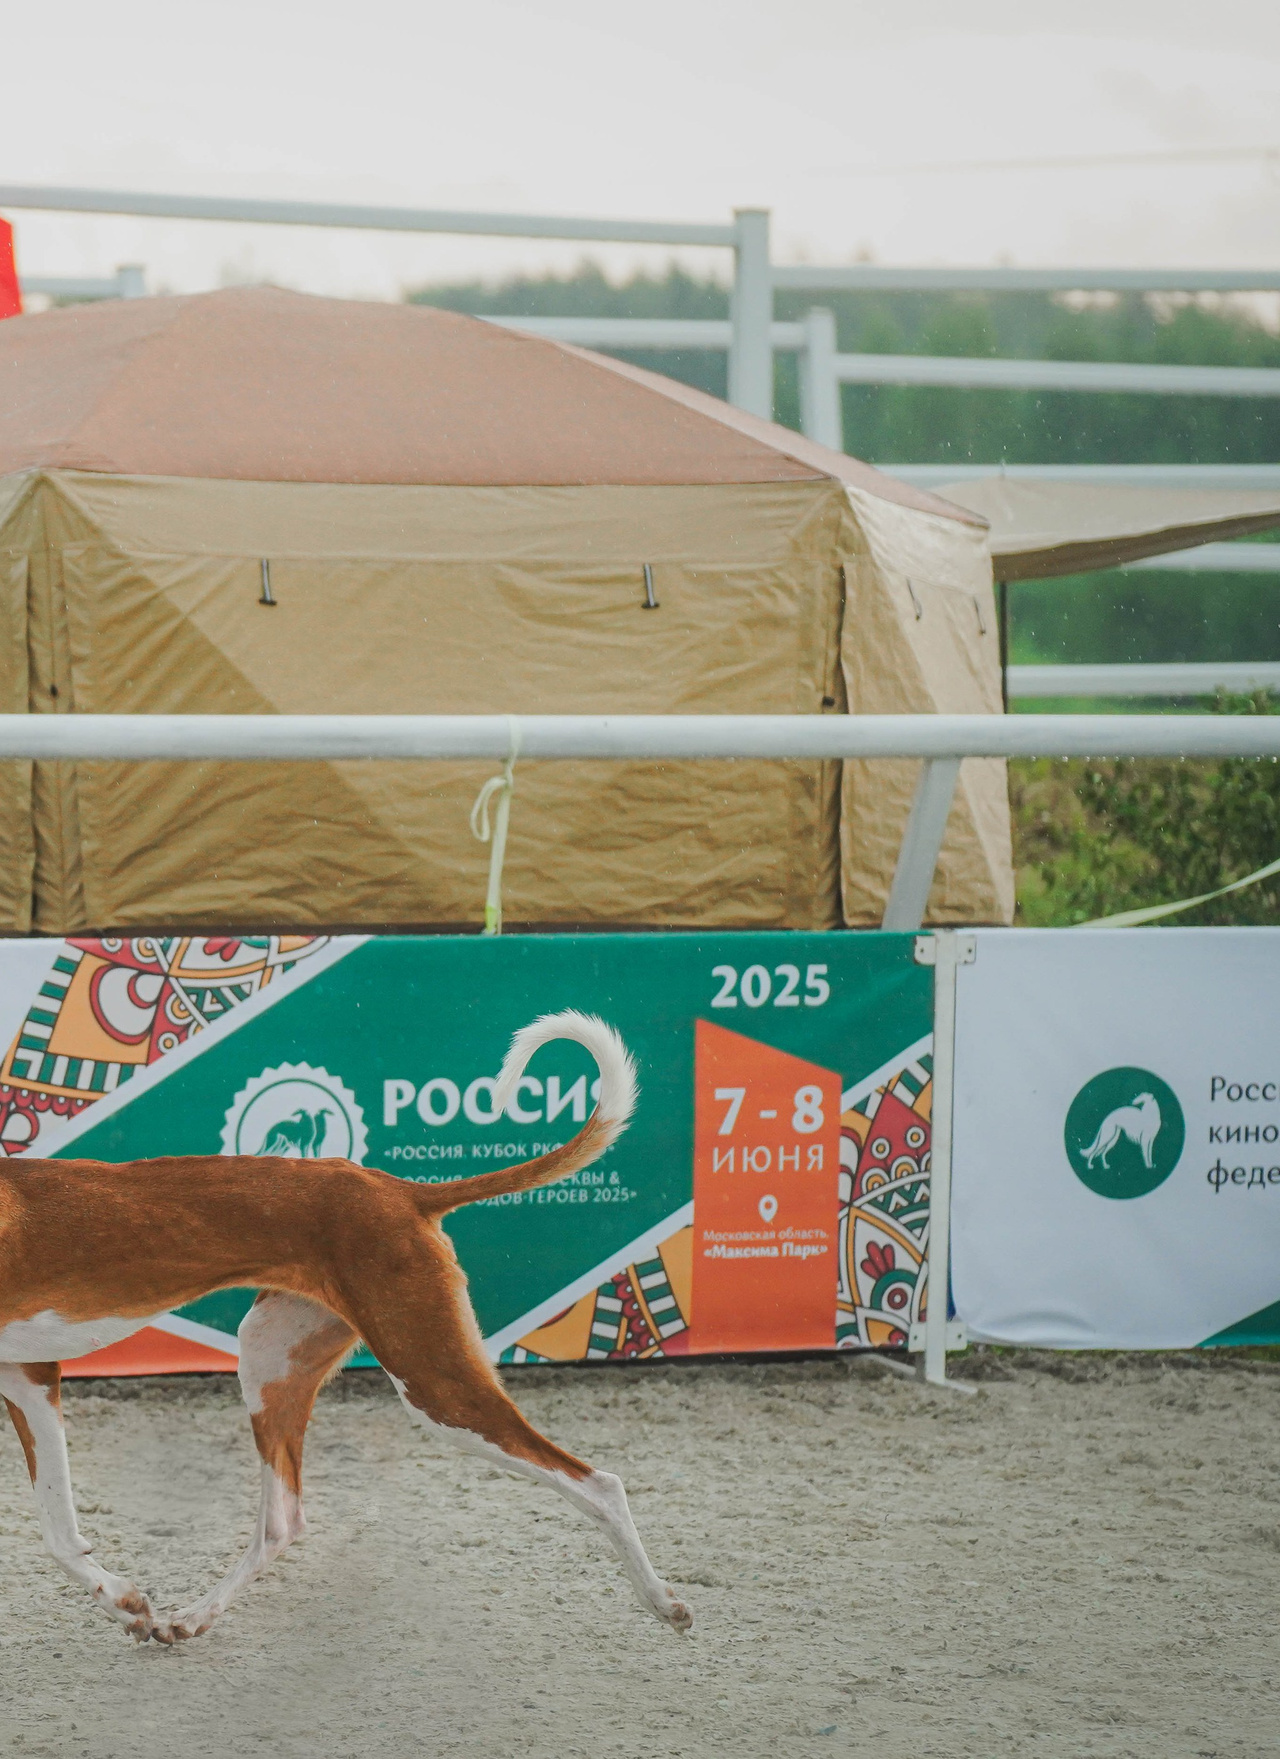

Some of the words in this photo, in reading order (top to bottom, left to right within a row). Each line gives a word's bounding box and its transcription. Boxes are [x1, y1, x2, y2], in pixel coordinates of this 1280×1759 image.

[711, 964, 830, 1008] 2025
[383, 1075, 602, 1126] РОССИ
[1211, 1076, 1280, 1102] Росс
[714, 1087, 746, 1135] 7
[759, 1109, 778, 1119] -
[792, 1085, 825, 1134] 8
[1209, 1124, 1279, 1144] кино
[472, 1143, 527, 1159] КУБОК
[712, 1144, 824, 1173] ИЮНЯ
[609, 1170, 621, 1186] &
[1207, 1157, 1280, 1194] феде
[592, 1187, 637, 1203] 2025»
[703, 1229, 776, 1242] Московская
[704, 1243, 779, 1258] «Максима
[782, 1242, 828, 1260] Парк»
